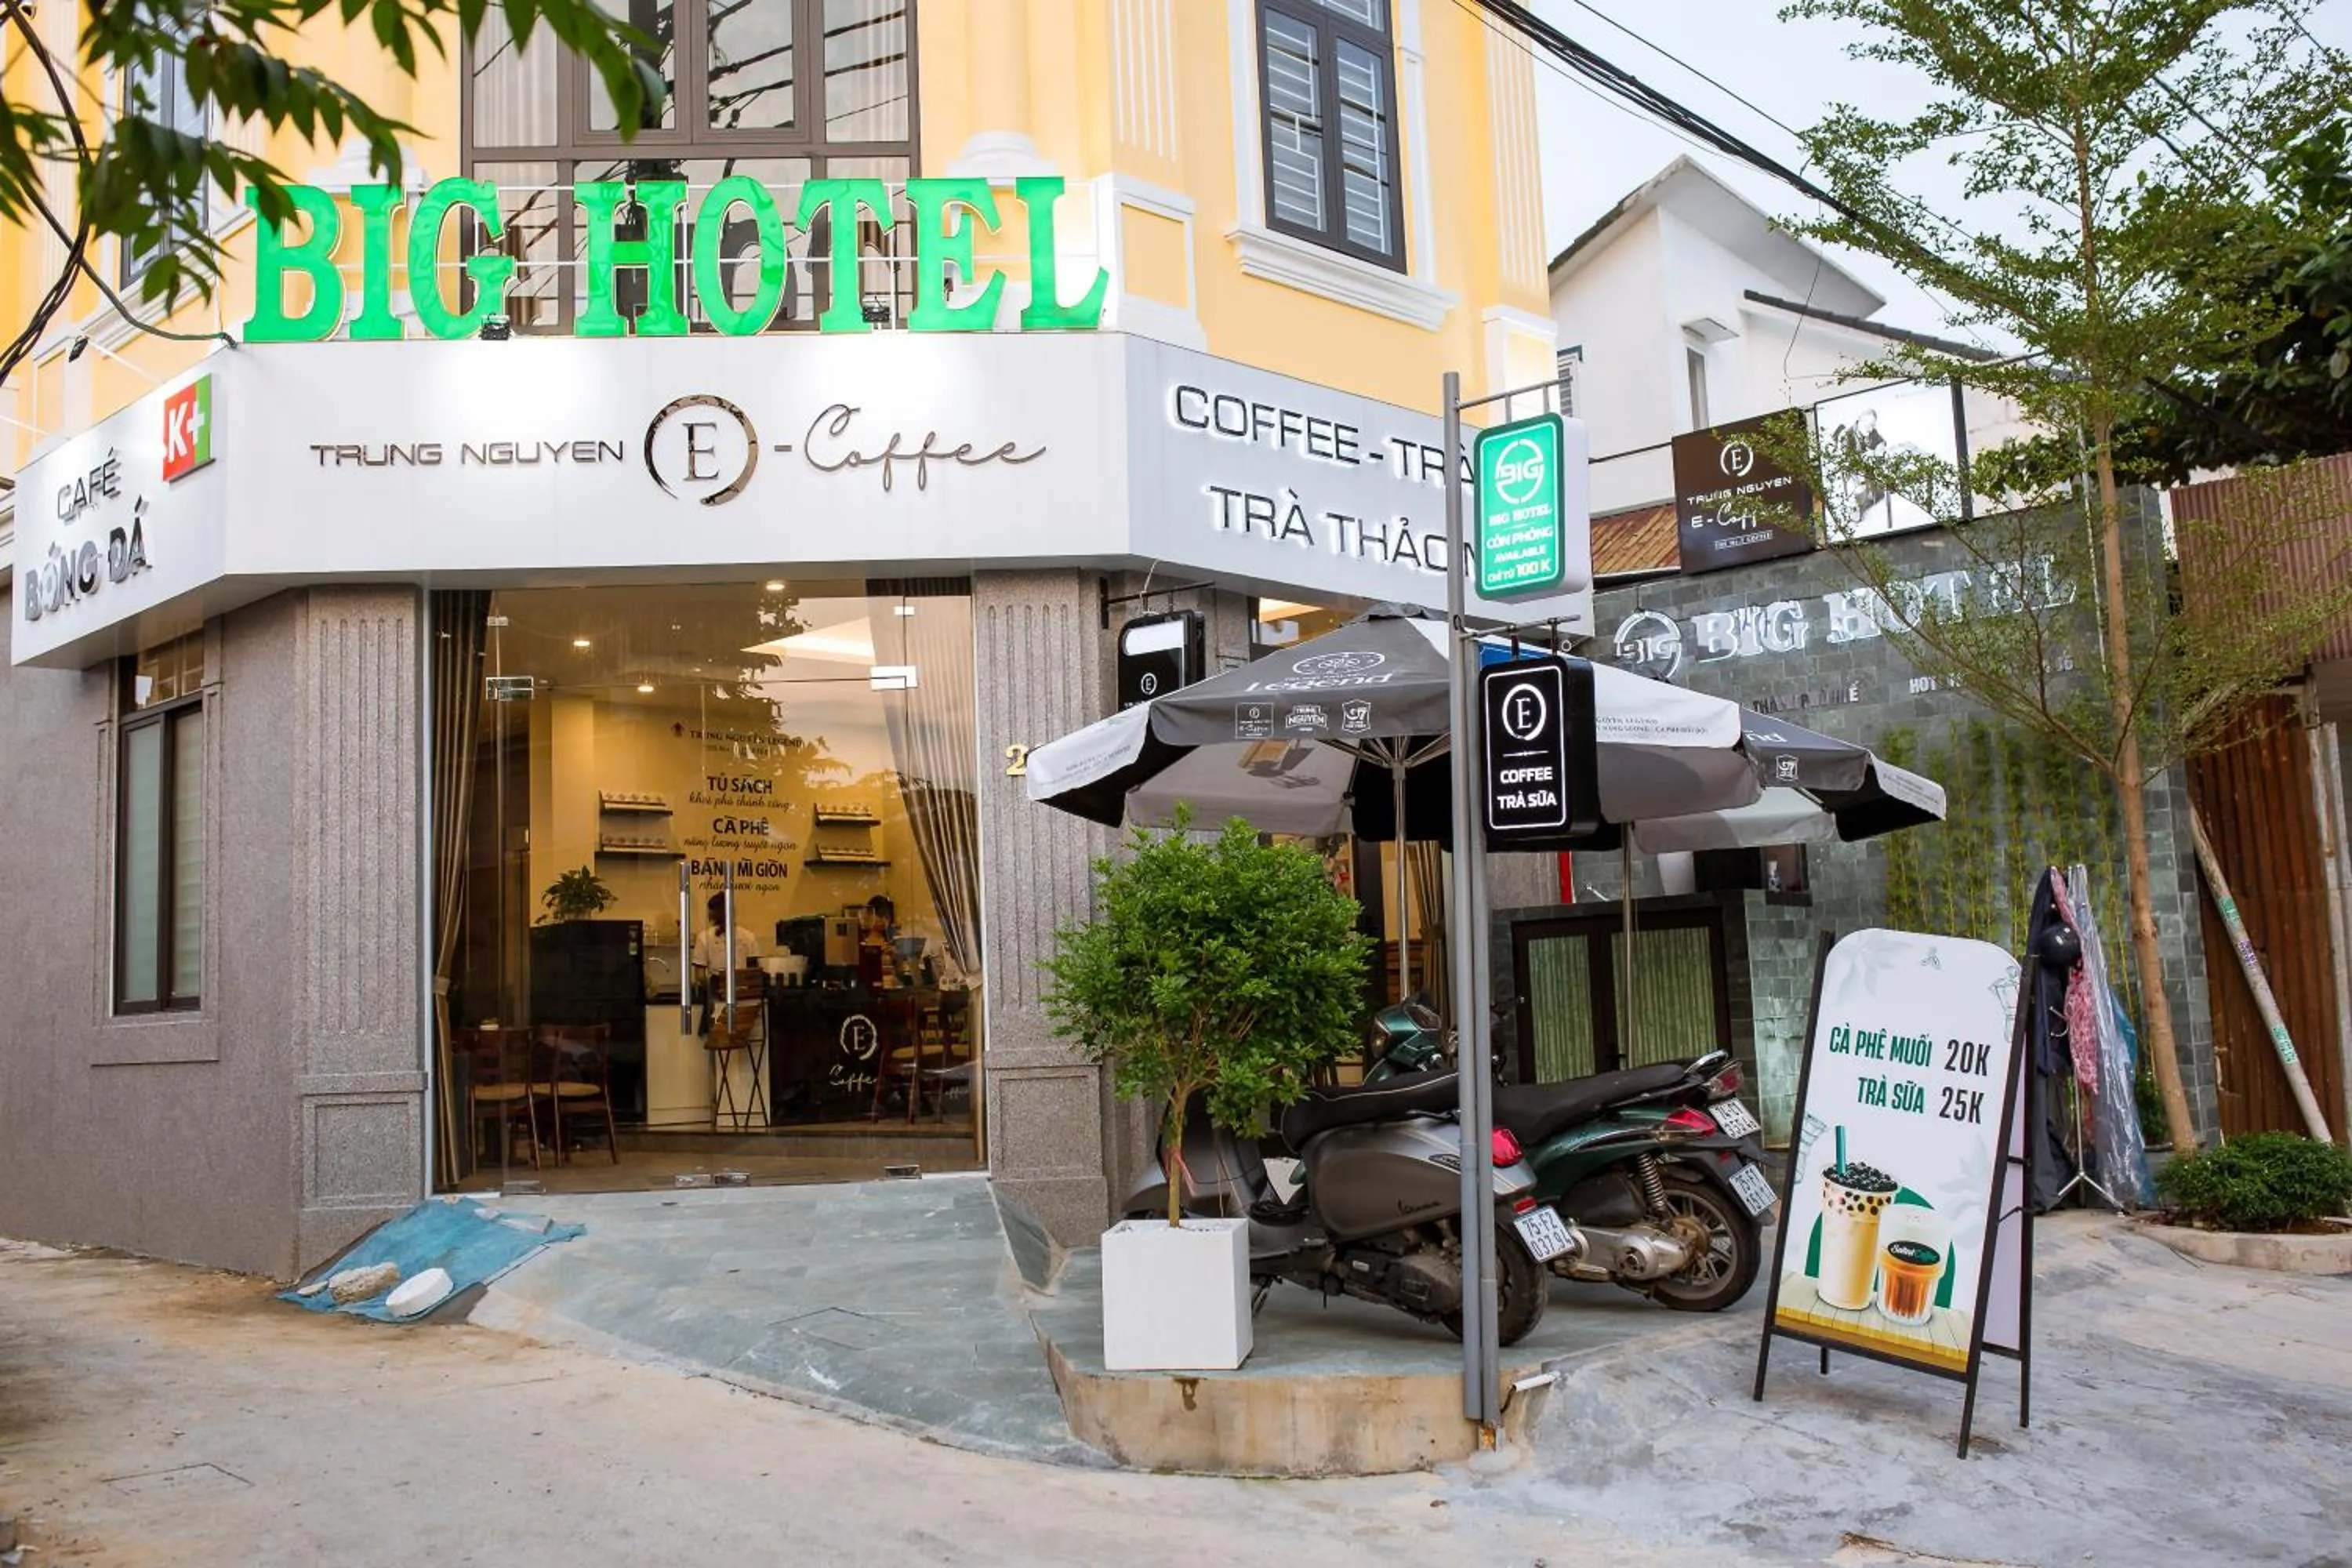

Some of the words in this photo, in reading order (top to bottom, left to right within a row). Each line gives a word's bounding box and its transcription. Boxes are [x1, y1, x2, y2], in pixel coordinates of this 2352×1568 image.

[242, 176, 517, 343] BIG
[573, 176, 1110, 337] HOTEL
[310, 443, 442, 466] TRUNG
[461, 441, 624, 465] NGUYEN
[804, 403, 1047, 492] Coffee
[1176, 385, 1360, 465] COFFEE
[1391, 437, 1475, 485] TRÀ
[57, 447, 120, 520] CAFÉ
[1736, 476, 1792, 495] NGUYEN
[1209, 487, 1315, 546] TRÀ
[1326, 517, 1448, 573] THẢO
[1513, 503, 1553, 521] HOTEL
[1494, 545, 1546, 564] AVAILABLE
[1515, 561, 1539, 577] 100
[1540, 558, 1552, 572] K
[25, 541, 97, 622] BÓNG
[1692, 599, 1809, 663] BIG
[1497, 790, 1526, 809] TRÀ
[1528, 789, 1557, 808] SỮA
[1500, 767, 1553, 784] COFFEE
[713, 815, 737, 835] CÀ
[739, 817, 769, 836] PHÊ
[691, 857, 726, 877] BÁN
[1829, 1022, 1851, 1055] CÀ
[1854, 1028, 1888, 1061] PHÊ
[1889, 1033, 1933, 1068] MUỐI
[1944, 1039, 1991, 1077] 20K
[1857, 1074, 1888, 1108] TRÀ
[1891, 1080, 1926, 1114] SỮA
[1939, 1086, 1985, 1125] 25K
